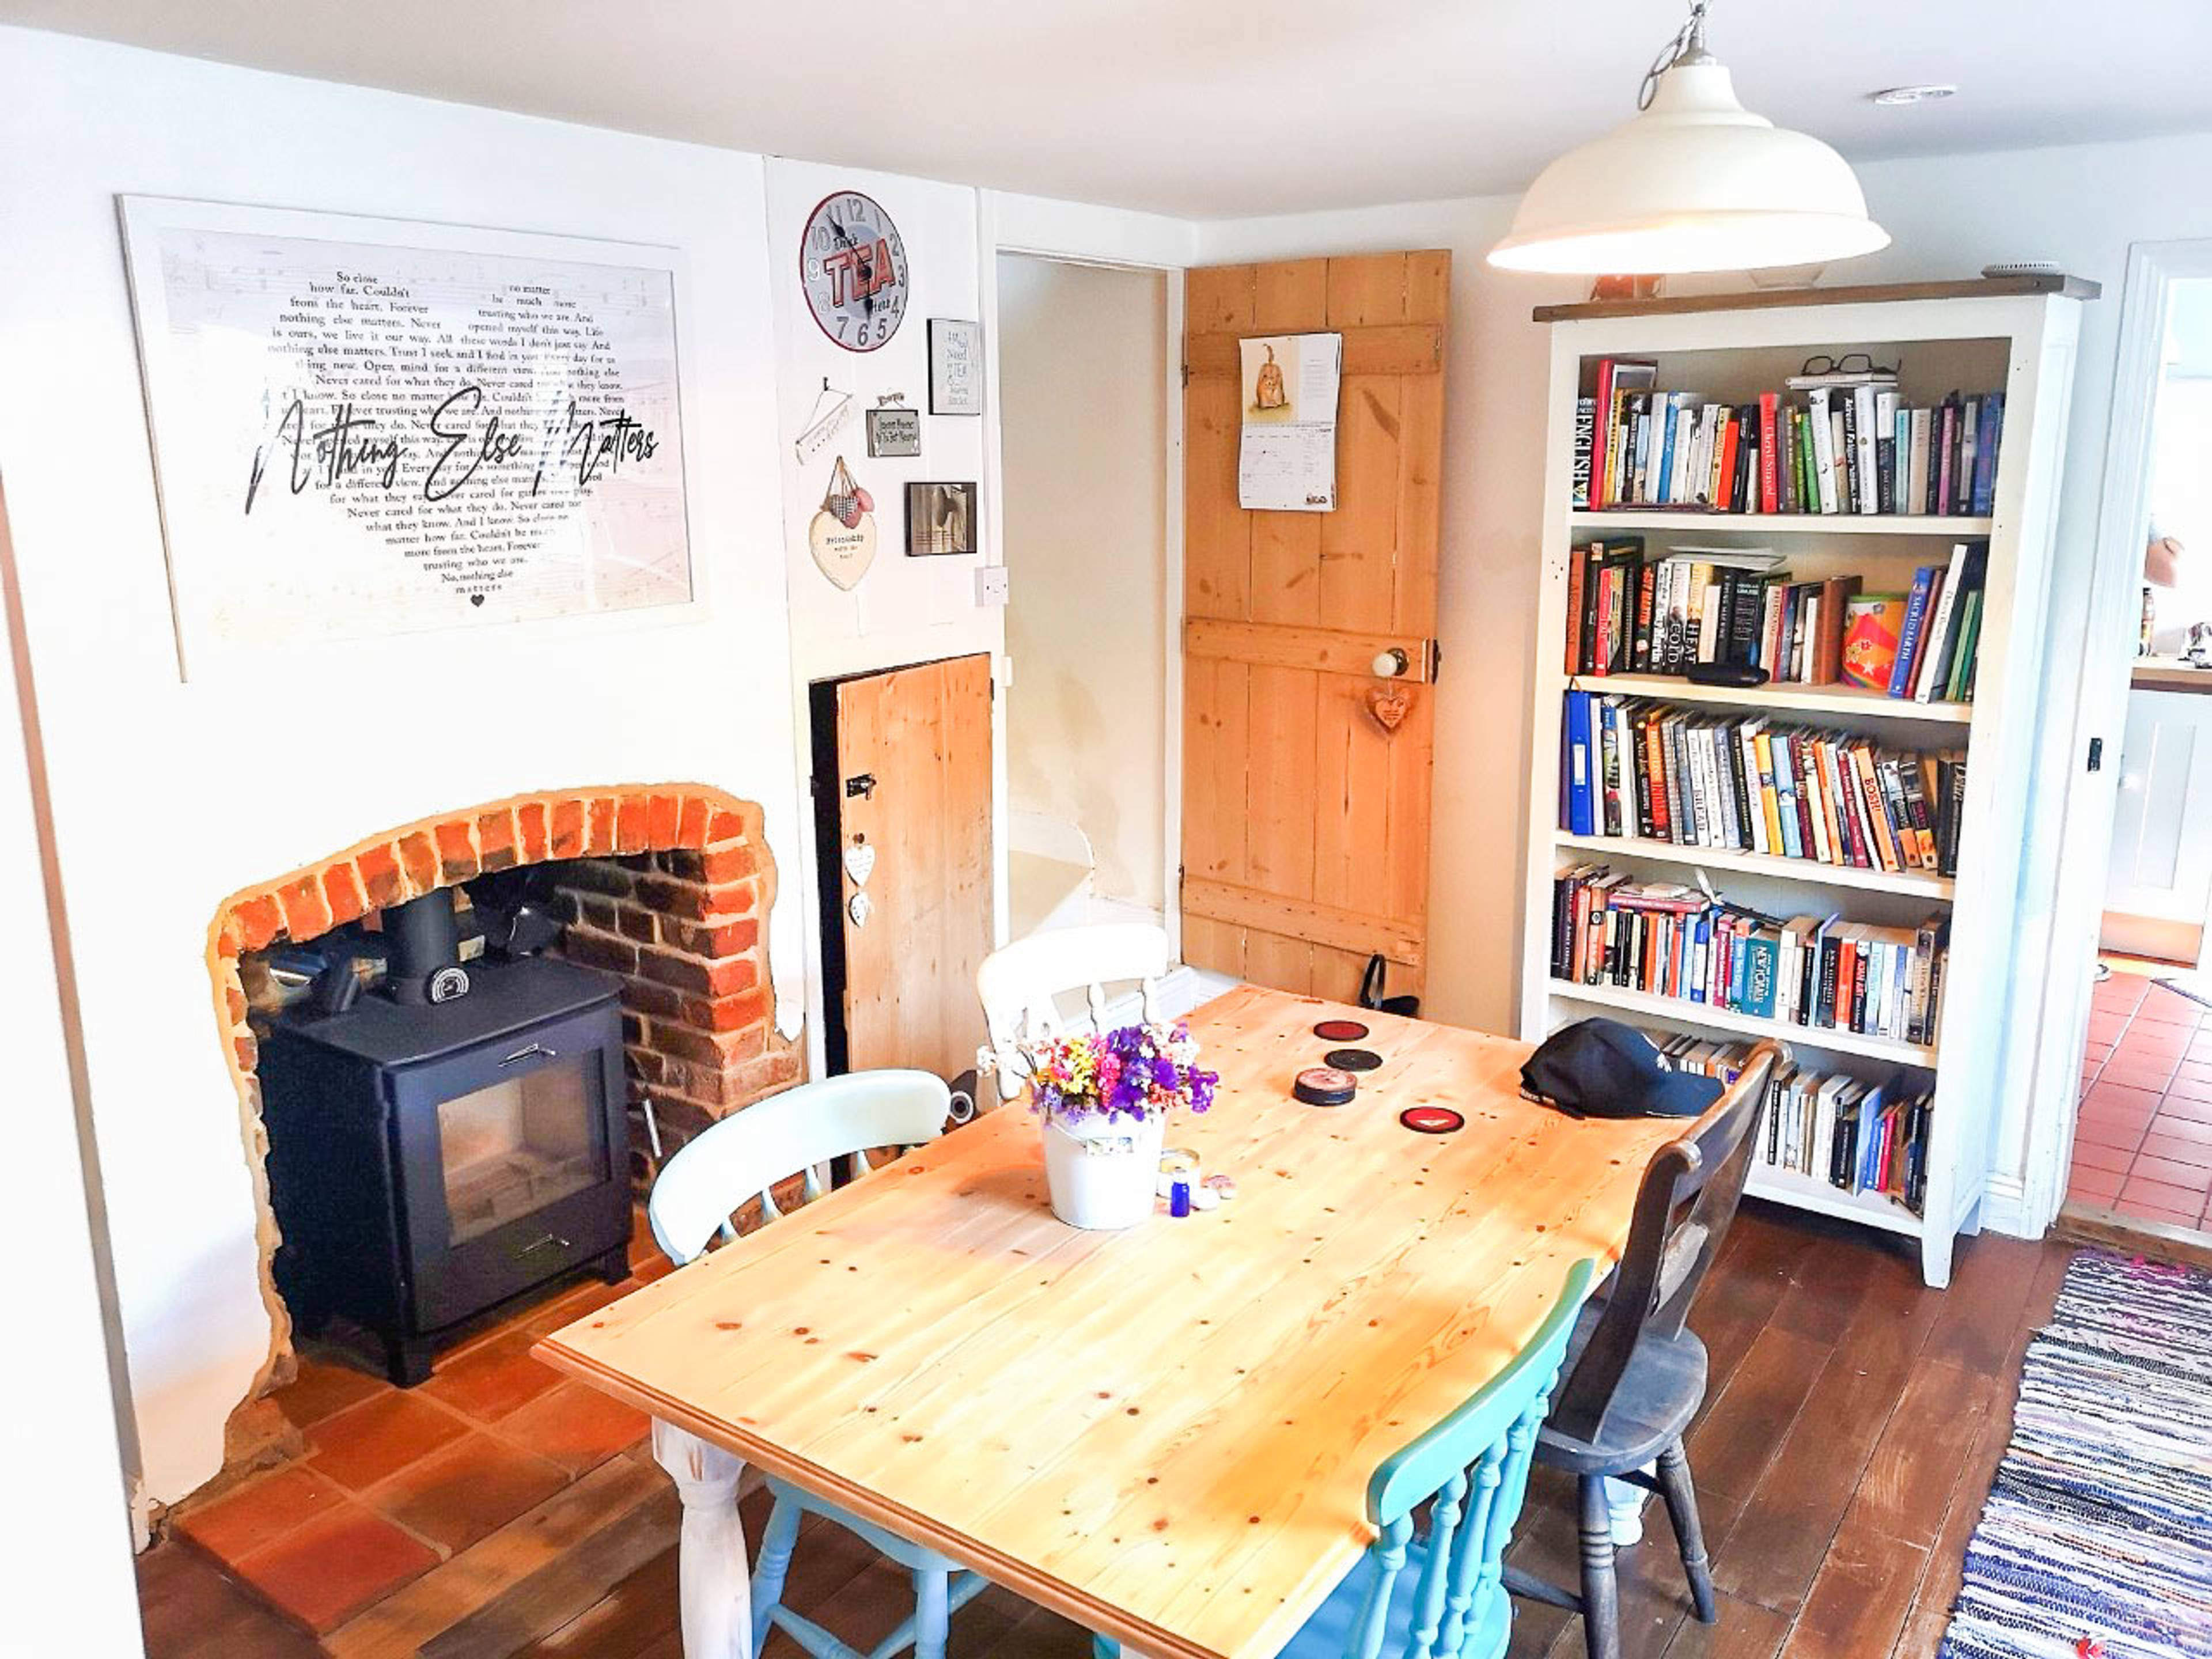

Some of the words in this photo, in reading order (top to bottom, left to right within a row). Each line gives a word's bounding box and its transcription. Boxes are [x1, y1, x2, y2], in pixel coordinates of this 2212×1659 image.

[847, 199, 864, 222] 12
[811, 227, 830, 251] 10
[890, 233, 899, 256] 2
[337, 271, 350, 282] So
[808, 257, 820, 281] 9
[824, 238, 895, 308] TEA
[898, 266, 904, 287] 3
[309, 282, 334, 293] how
[327, 299, 344, 309] the
[279, 313, 325, 327] nothing
[334, 315, 353, 325] else
[836, 316, 849, 339] 7
[273, 327, 282, 337] is
[346, 330, 364, 340] live
[372, 331, 378, 341] it
[437, 334, 453, 344] All
[858, 323, 868, 346] 6
[877, 318, 887, 339] 5
[318, 344, 338, 355] else
[391, 346, 418, 357] Trust
[401, 363, 428, 372] mind
[316, 375, 349, 385] Never
[353, 375, 381, 385] cared
[385, 376, 401, 385] for
[404, 376, 430, 386] what
[434, 377, 456, 389] they
[342, 389, 356, 400] So
[361, 390, 387, 400] close
[376, 406, 417, 418] trusting
[245, 399, 408, 514] Nothing
[424, 386, 522, 502] Else
[1574, 415, 1593, 485] ENGLISH
[352, 492, 378, 502] what
[385, 493, 408, 504] they
[347, 507, 380, 518] Never
[385, 506, 412, 516] cared
[418, 504, 433, 514] for
[437, 503, 461, 513] what
[467, 502, 487, 515] they
[510, 501, 537, 511] Never
[396, 521, 419, 532] they
[455, 517, 476, 527] And
[425, 533, 446, 543] how
[468, 558, 488, 567] who
[460, 571, 495, 582] nothing
[1685, 623, 1699, 664] HEAT
